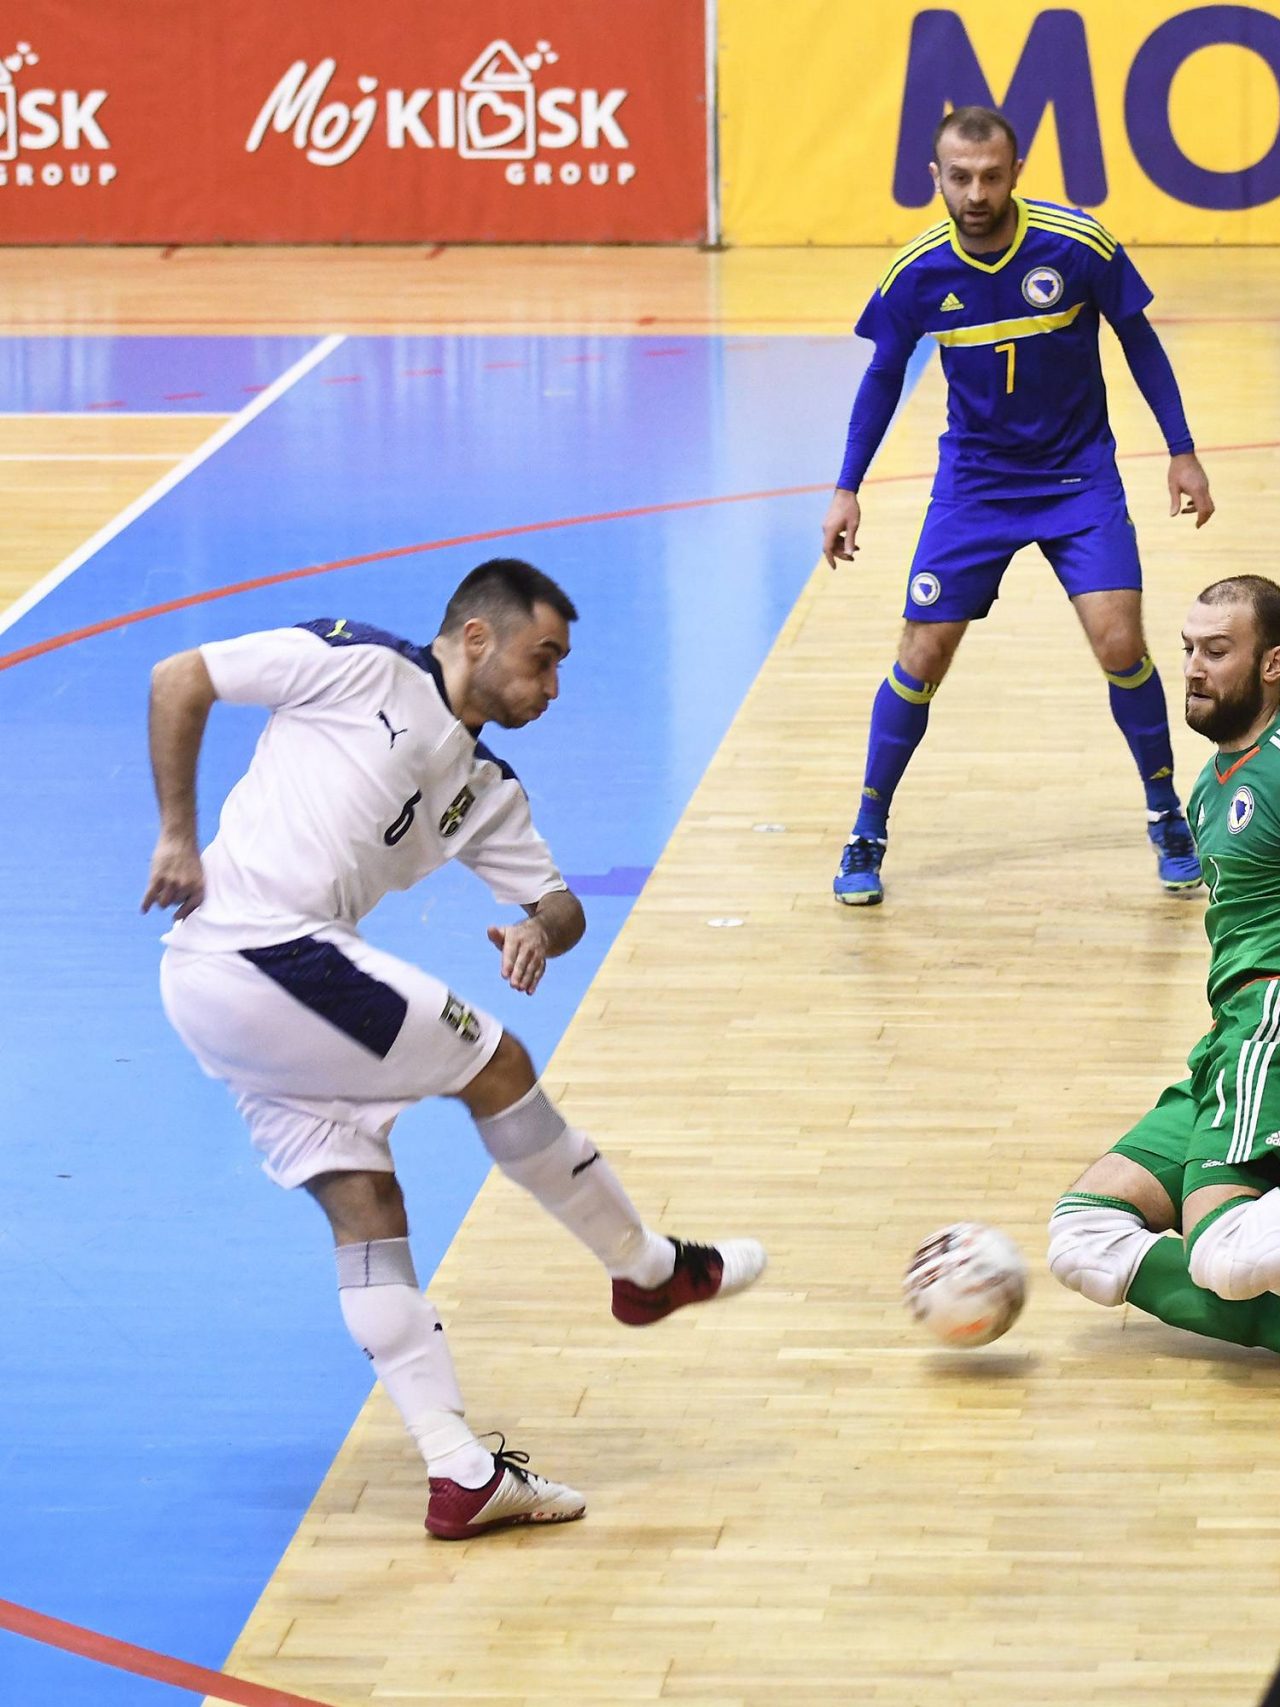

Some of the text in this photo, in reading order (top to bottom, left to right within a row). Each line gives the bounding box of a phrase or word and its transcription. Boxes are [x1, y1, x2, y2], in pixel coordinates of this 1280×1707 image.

[505, 163, 636, 187] GROUP
[995, 342, 1016, 394] 7
[384, 789, 422, 847] 6
